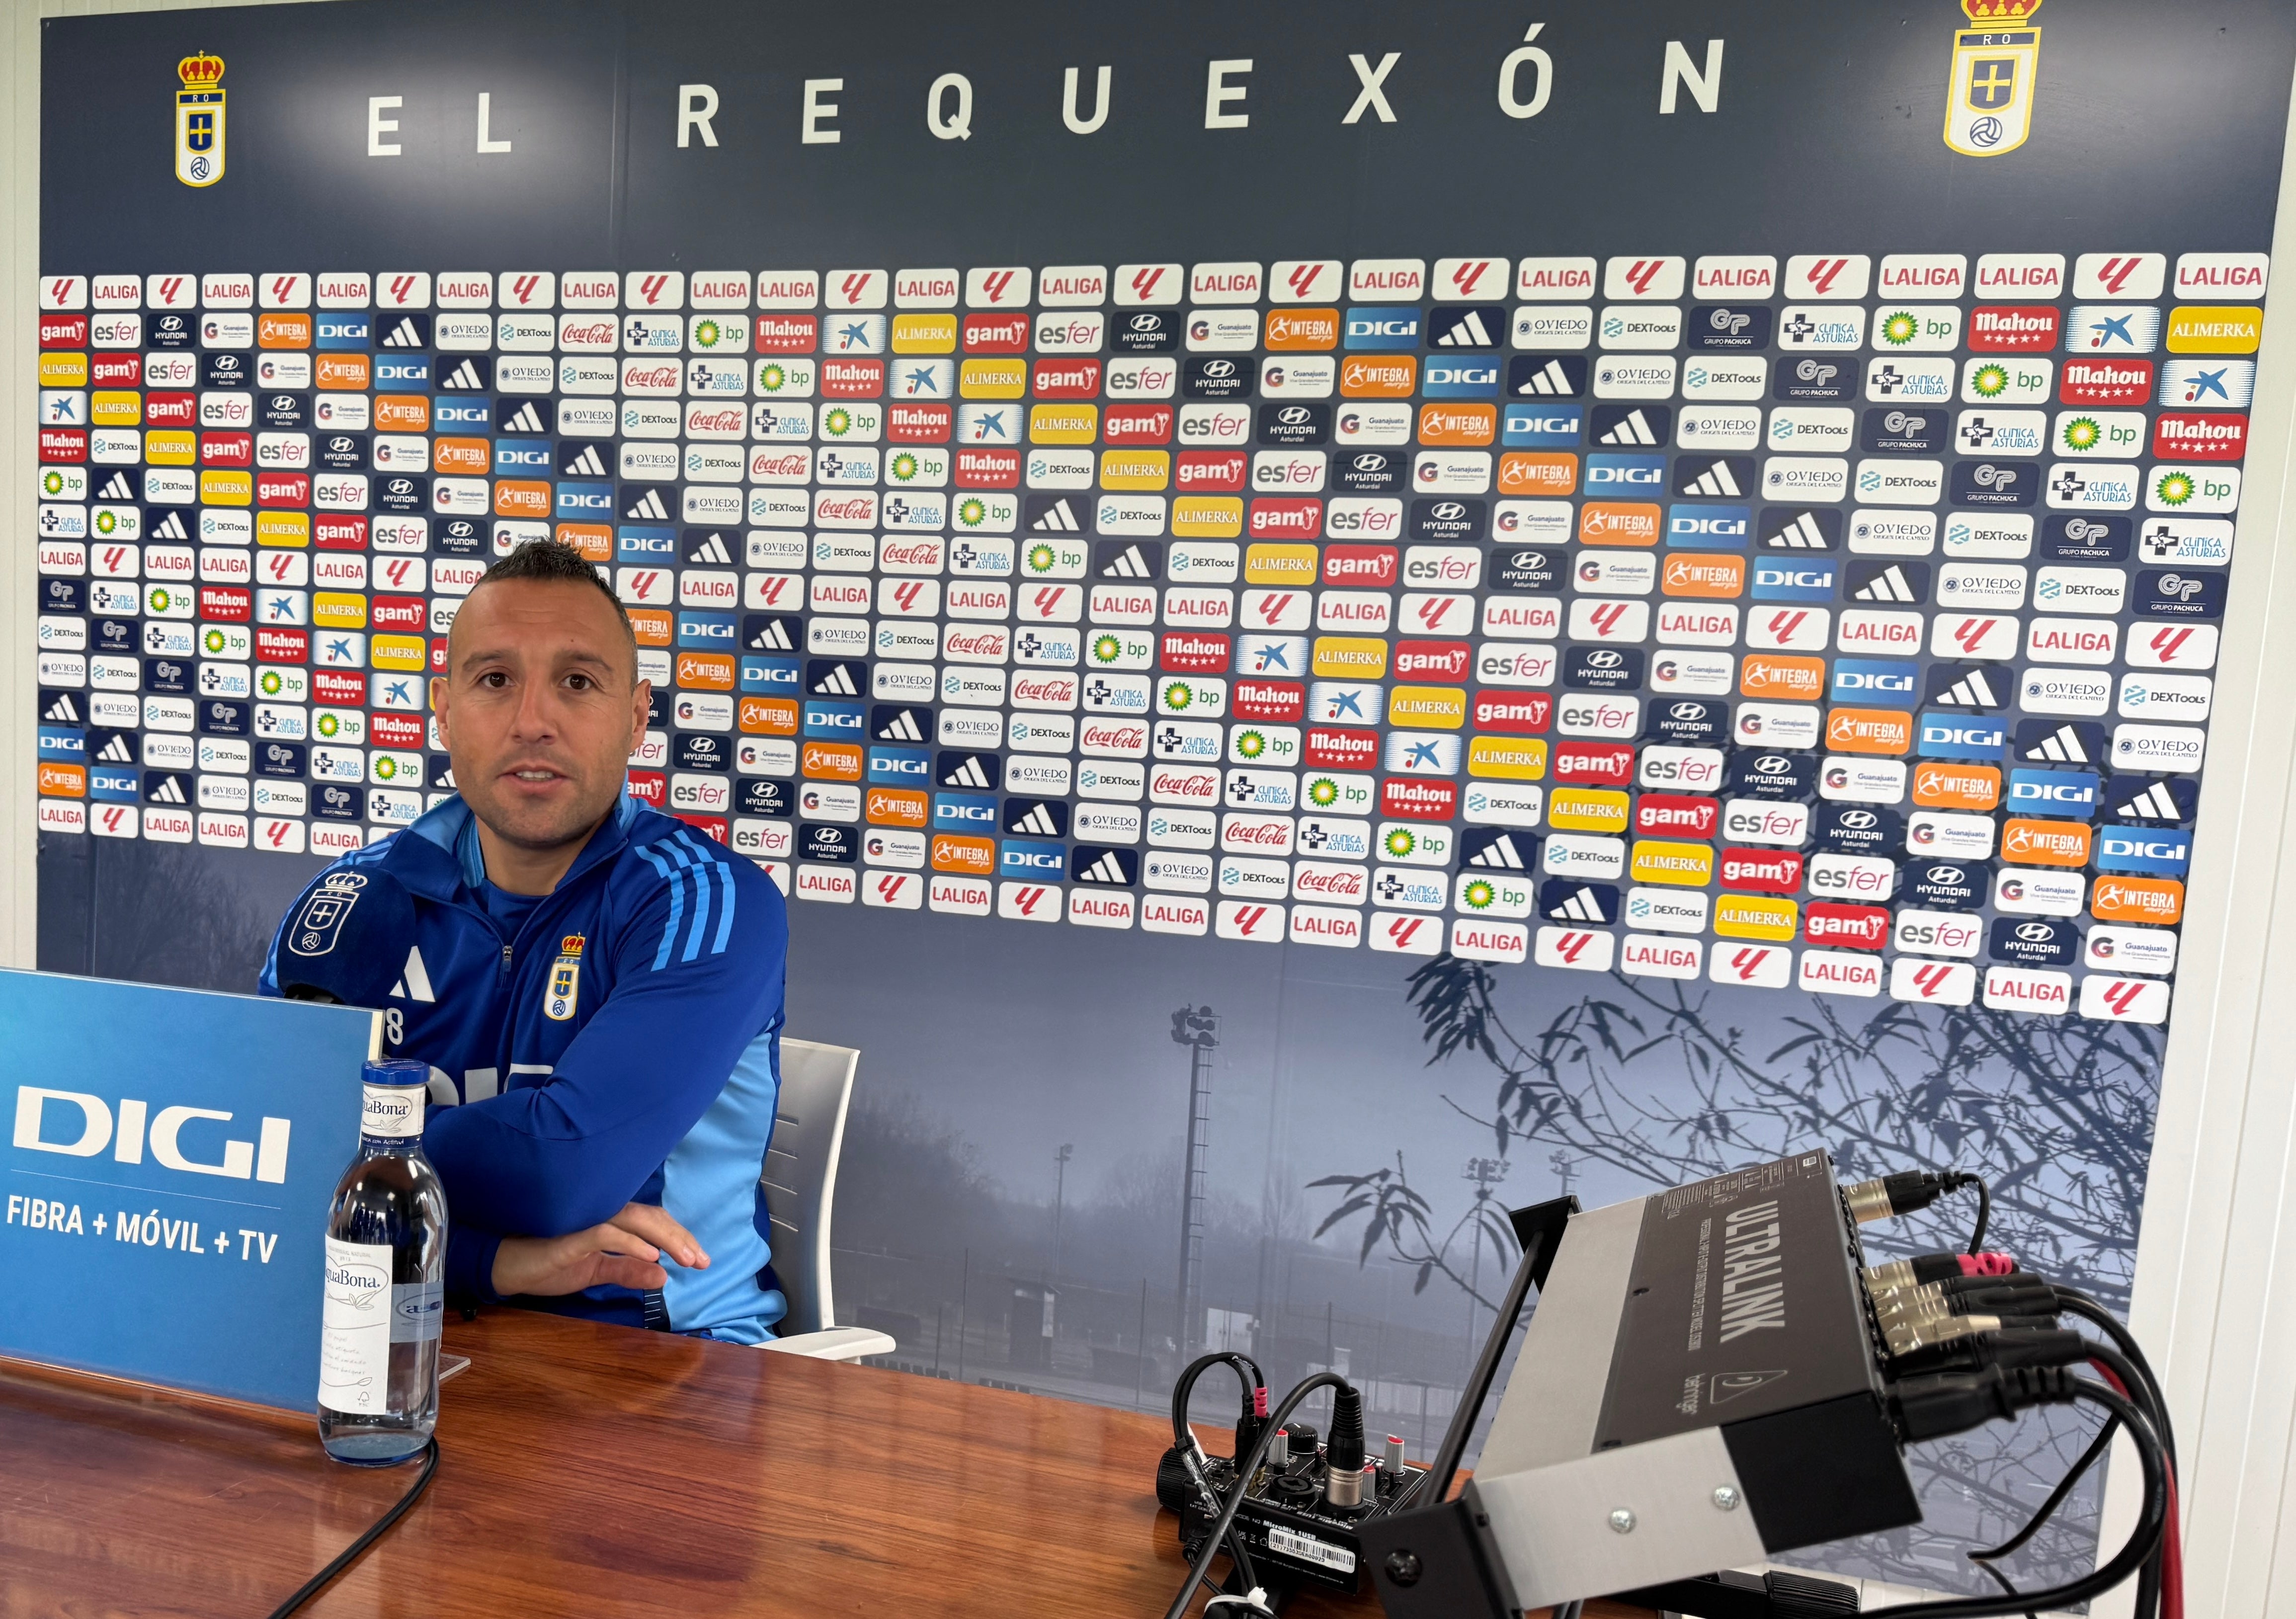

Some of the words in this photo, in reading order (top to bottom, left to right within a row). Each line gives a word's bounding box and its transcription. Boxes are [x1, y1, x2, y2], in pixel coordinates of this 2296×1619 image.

[368, 92, 511, 157] EL
[677, 23, 1724, 148] REQUEXÓN
[1353, 271, 1419, 288] LALIGA
[1698, 269, 1770, 286] LALIGA
[2179, 267, 2261, 285] LALIGA
[95, 285, 138, 299] LALIGA
[320, 283, 367, 297] LALIGA
[564, 283, 615, 298] LALIGA
[898, 280, 955, 296] LALIGA
[451, 325, 489, 333] OVIEDO
[759, 320, 813, 336] Mahou
[1288, 319, 1332, 336] INTEGRA
[1348, 321, 1417, 335] DIGI
[1534, 320, 1587, 329] OVIEDO
[1975, 312, 2052, 331] Mahou
[2172, 323, 2255, 337] ALIMERKA
[94, 321, 138, 340] esfer
[318, 324, 367, 337] DIGI
[562, 323, 614, 343] Coca-Cola
[726, 325, 743, 342] bp
[895, 327, 952, 339] ALIMERKA
[1039, 321, 1099, 344] esfer
[1122, 332, 1166, 341] HYUNDAI
[41, 364, 84, 374] ALIMERKA
[2017, 371, 2043, 391] bp
[688, 410, 742, 431] Coca-Cola
[892, 408, 947, 425] Mahou
[1182, 412, 1246, 436] esfer
[1443, 413, 1489, 432] INTEGRA
[1506, 417, 1578, 433] DIGI
[2161, 419, 2241, 439] Mahou
[41, 433, 84, 447] Mahou
[259, 440, 306, 460] esfer
[497, 450, 549, 464] DIGI
[636, 454, 675, 464] OVIEDO
[924, 459, 942, 476] bp
[1104, 464, 1164, 476] ALIMERKA
[68, 476, 82, 490] bp
[2204, 480, 2230, 500] bp
[817, 498, 874, 519] Coca-Cola
[1330, 506, 1397, 530] esfer
[1422, 521, 1471, 530] HYUNDAI
[259, 523, 306, 535] ALIMERKA
[41, 551, 83, 566] LALIGA
[316, 563, 363, 578] LALIGA
[1685, 564, 1737, 582] INTEGRA
[1755, 570, 1832, 587] DIGI
[1962, 577, 2021, 589] OVIEDO
[175, 594, 189, 609] bp
[814, 586, 867, 602] LALIGA
[1167, 599, 1229, 616] LALIGA
[2173, 604, 2203, 613] PACHUCA
[1661, 614, 1732, 633] LALIGA
[946, 633, 1005, 655] Coca-Cola
[1165, 638, 1225, 655] Mahou
[2032, 631, 2110, 651] LALIGA
[374, 647, 422, 659] ALIMERKA
[1318, 650, 1382, 664] ALIMERKA
[315, 674, 362, 690] Mahou
[743, 667, 797, 682] DIGI
[1835, 672, 1913, 691] DIGI
[2046, 683, 2105, 695] OVIEDO
[1199, 689, 1219, 707] bp
[1562, 704, 1634, 728] esfer
[1660, 721, 1712, 731] HYUNDAI
[39, 736, 83, 750] DIGI
[683, 752, 720, 761] HYUNDAI
[1473, 750, 1542, 766] ALIMERKA
[1153, 773, 1216, 796] Coca-Cola
[1938, 774, 1993, 794] INTEGRA
[673, 783, 726, 804] esfer
[884, 797, 923, 815] INTEGRA
[1092, 815, 1137, 826] OVIEDO
[1728, 810, 1803, 835] esfer
[200, 822, 245, 838] LALIGA
[1830, 828, 1883, 840] HYUNDAI
[1423, 836, 1444, 854] bp
[2103, 839, 2185, 860] DIGI
[1003, 851, 1062, 869] DIGI
[1297, 870, 1363, 894] Coca-Cola
[2034, 885, 2075, 894] Guanajuato
[2123, 887, 2175, 910] INTEGRA
[1072, 898, 1130, 918] LALIGA
[1719, 909, 1792, 927] ALIMERKA
[1899, 922, 1976, 947] esfer
[2005, 941, 2060, 954] HYUNDAI
[2125, 942, 2167, 952] Guanajuato
[1626, 946, 1696, 967] LALIGA
[1988, 979, 2064, 1002] LALIGA
[13, 1085, 291, 1184] DIGI
[7, 1195, 83, 1235] FIBRA
[116, 1209, 204, 1254] MÓVIL
[239, 1229, 278, 1263] TV
[1720, 1200, 1786, 1343] ULTRALINK
[1263, 1520, 1296, 1535] MicroMix
